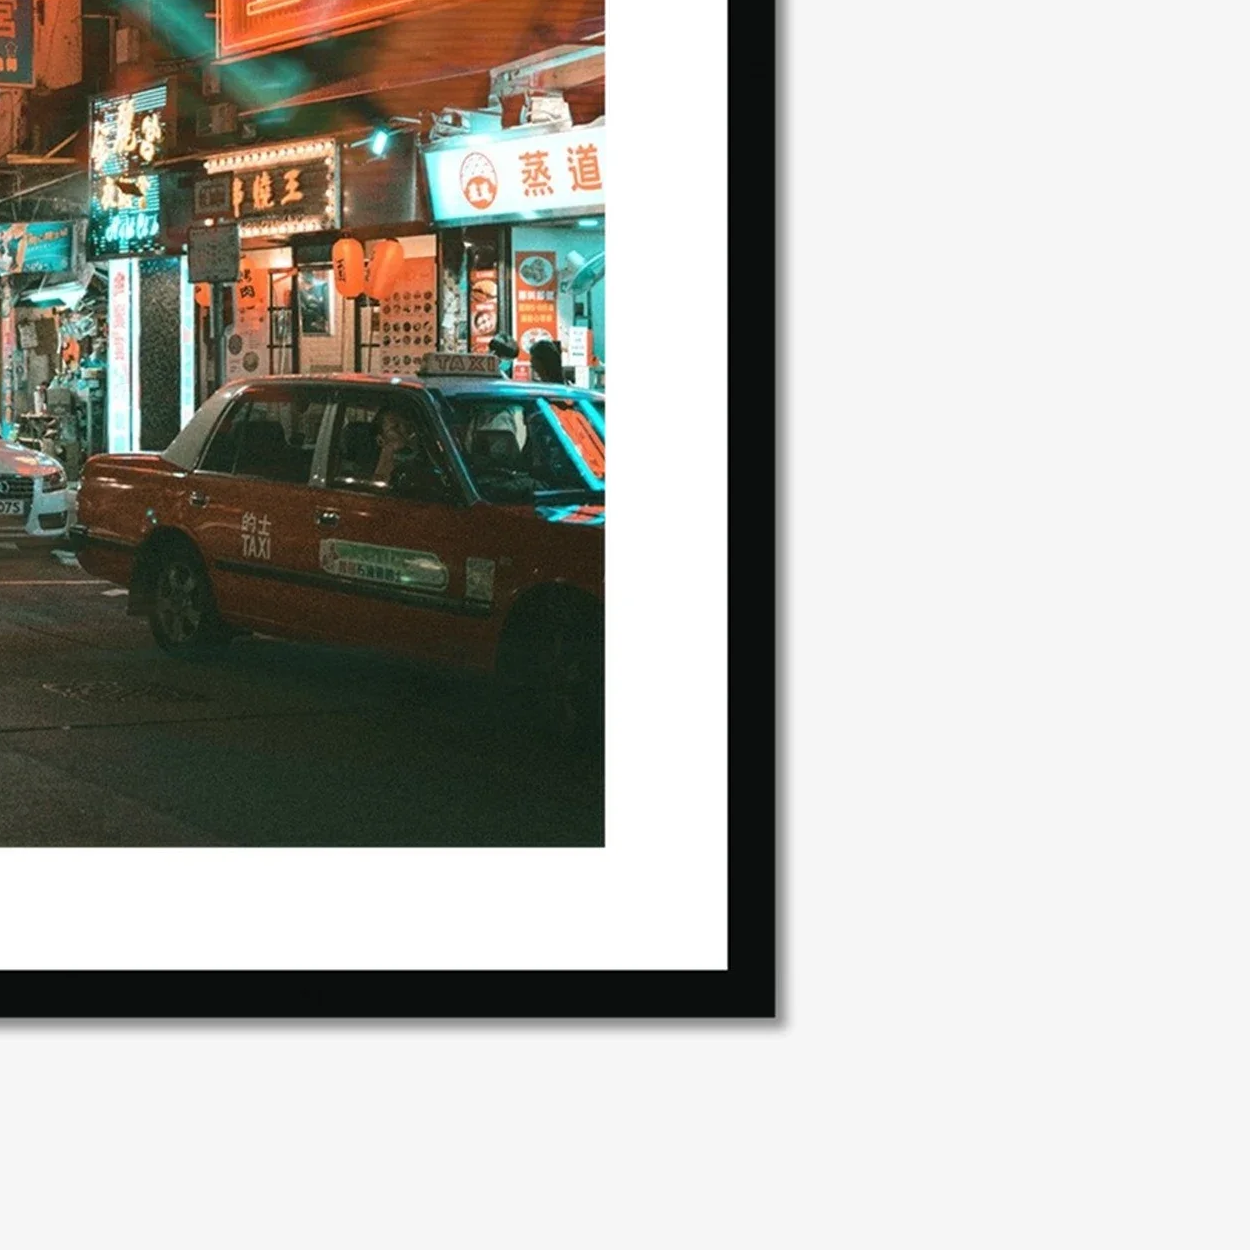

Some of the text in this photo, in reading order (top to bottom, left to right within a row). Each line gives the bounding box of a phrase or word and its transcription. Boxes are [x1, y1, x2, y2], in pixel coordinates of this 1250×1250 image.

[518, 142, 603, 197] 蒸道
[434, 354, 496, 373] TAXI
[241, 511, 272, 536] 的士
[241, 534, 271, 560] TAXI
